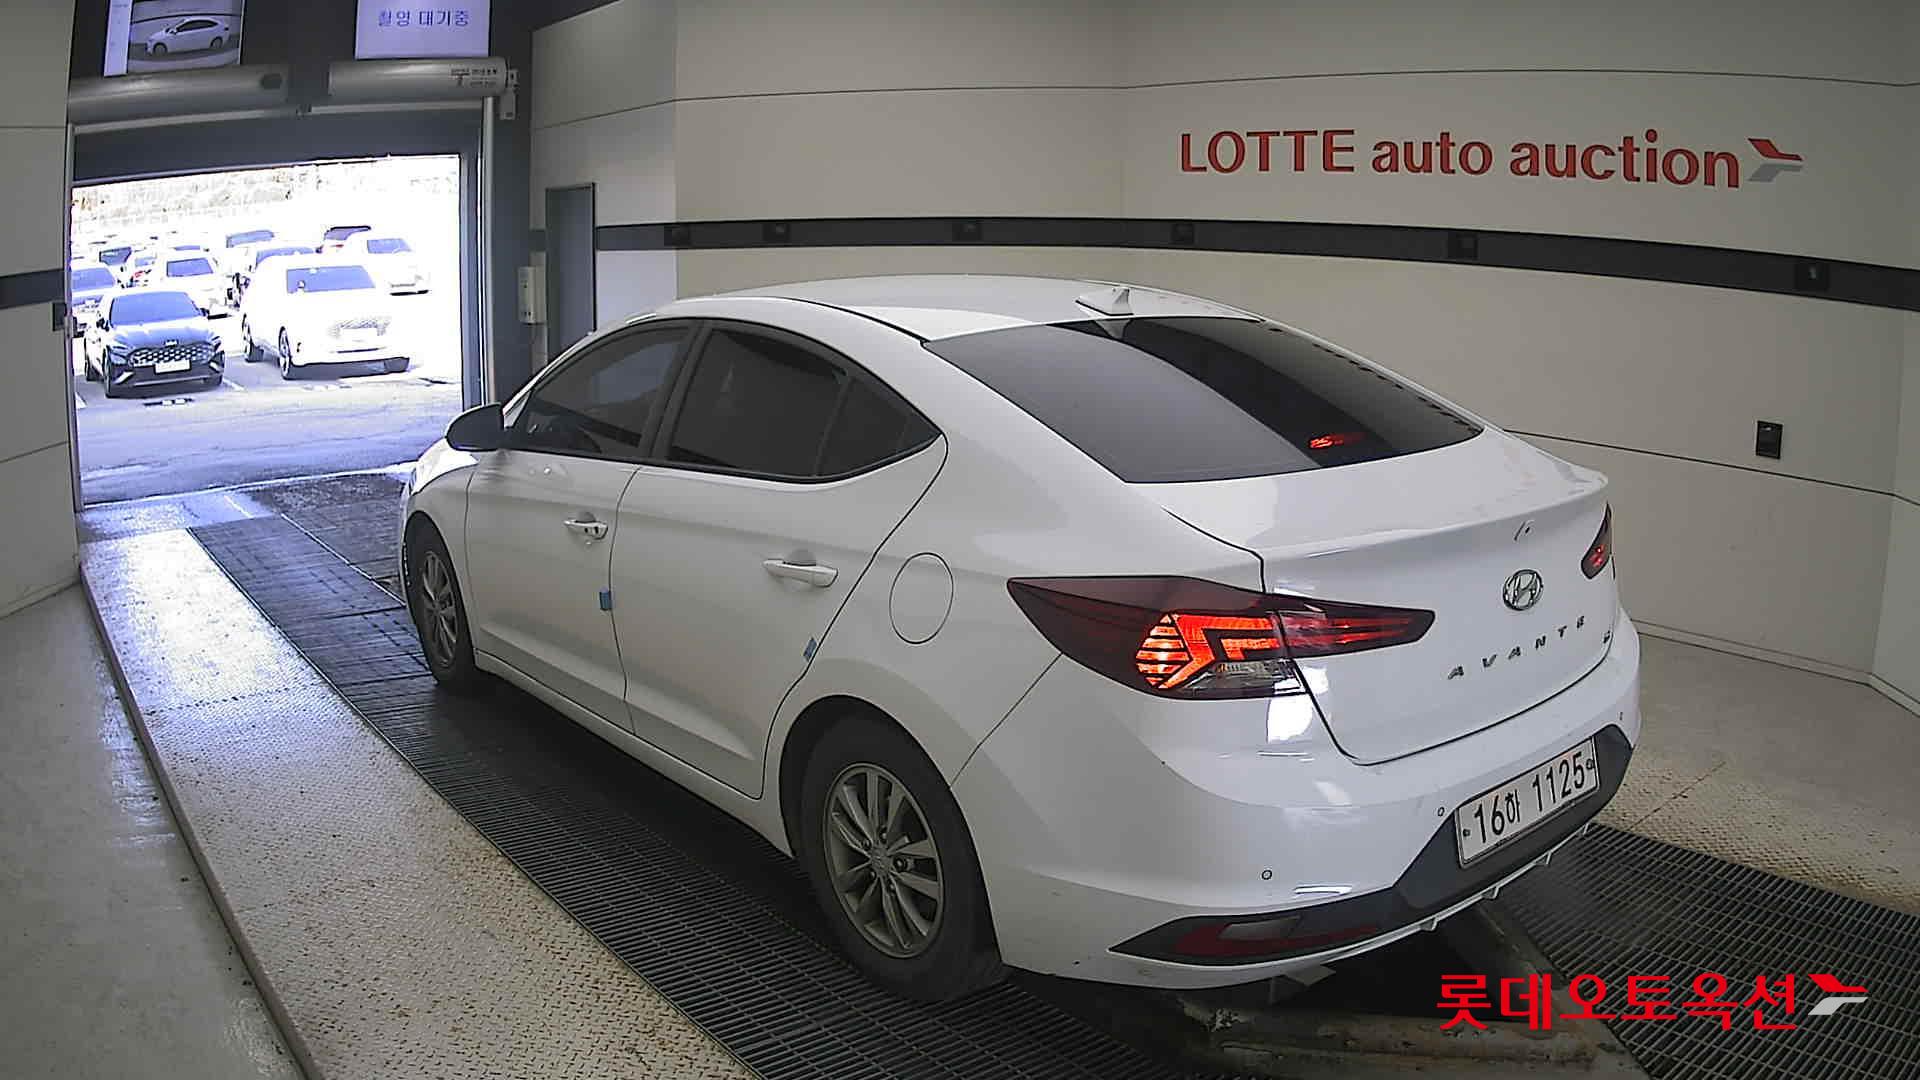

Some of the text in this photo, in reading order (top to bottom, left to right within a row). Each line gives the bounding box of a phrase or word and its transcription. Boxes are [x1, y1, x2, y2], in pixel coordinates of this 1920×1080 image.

[418, 9, 469, 27] 대기중
[1181, 129, 1740, 189] LOTTE auto auction
[1448, 615, 1585, 680] AVANTE
[1474, 751, 1585, 843] 16하 1125
